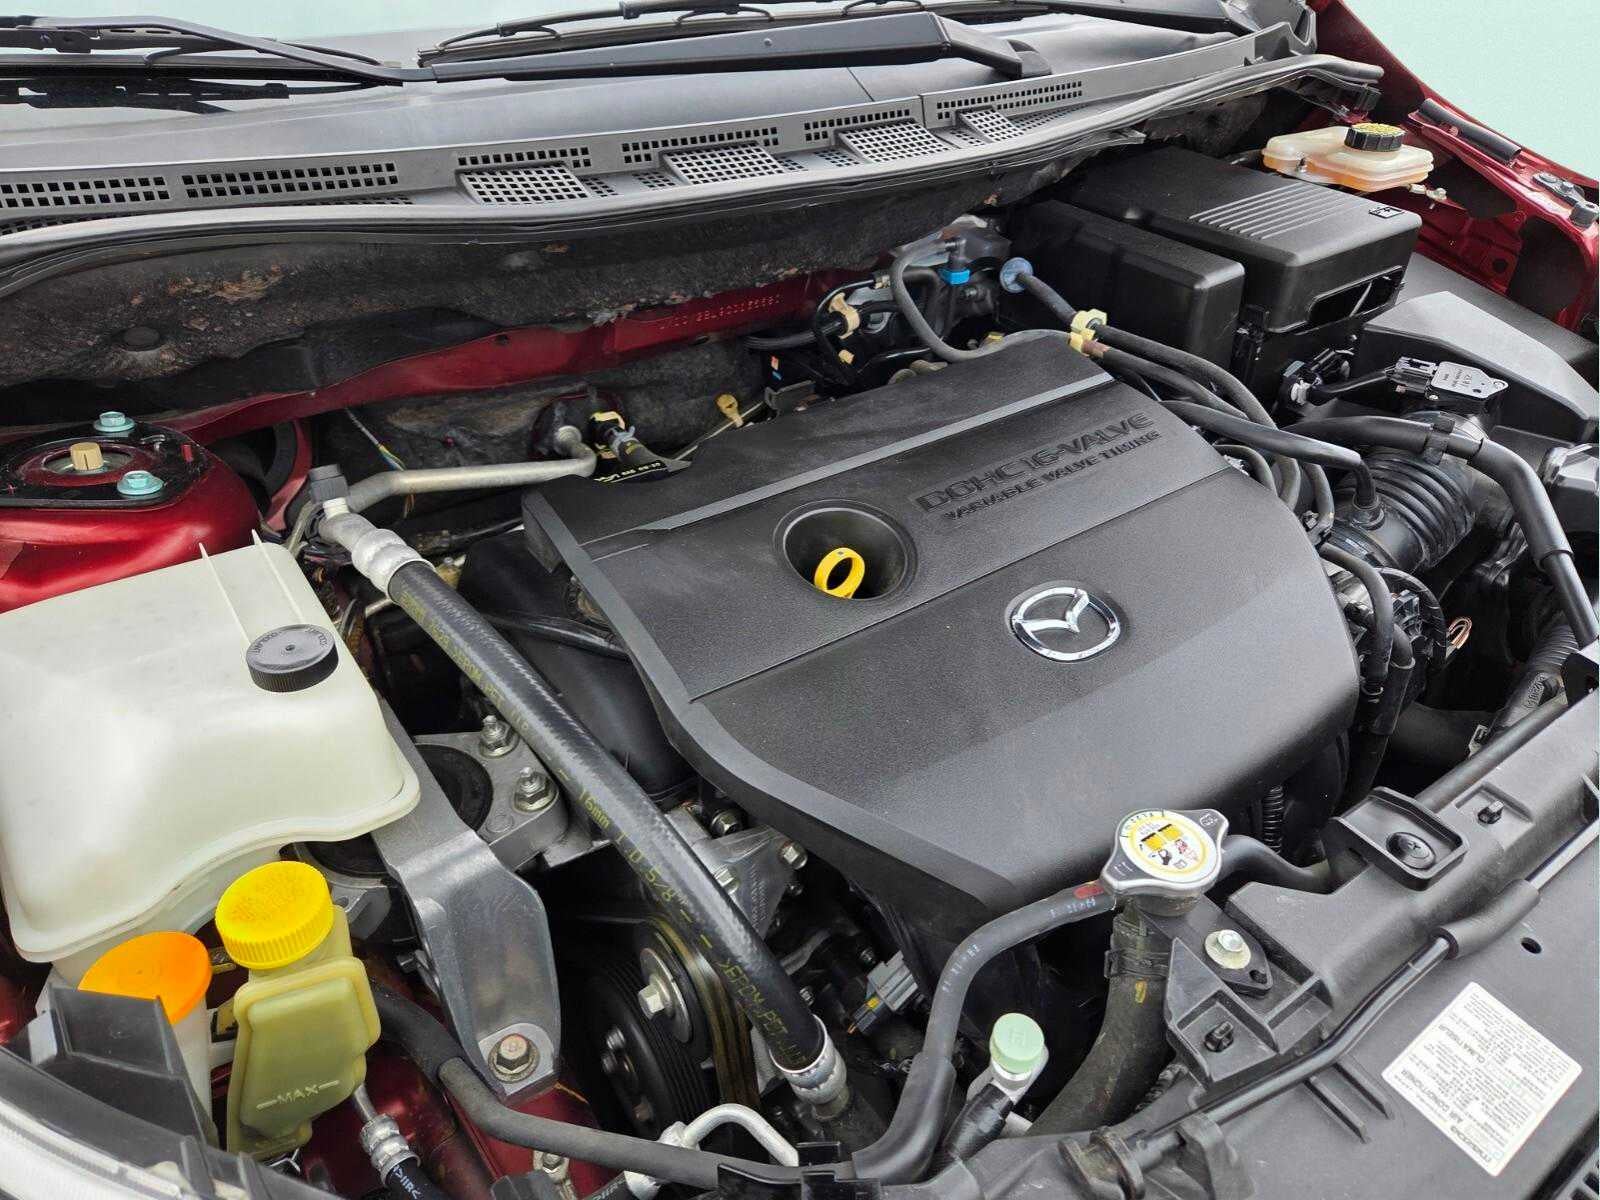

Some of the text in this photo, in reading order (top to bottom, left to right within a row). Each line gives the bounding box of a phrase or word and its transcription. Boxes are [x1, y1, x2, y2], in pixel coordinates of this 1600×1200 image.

[1040, 455, 1099, 481] VALVE
[1098, 430, 1162, 459] TIMING
[916, 462, 1025, 512] DOHC
[277, 1083, 320, 1104] MAX
